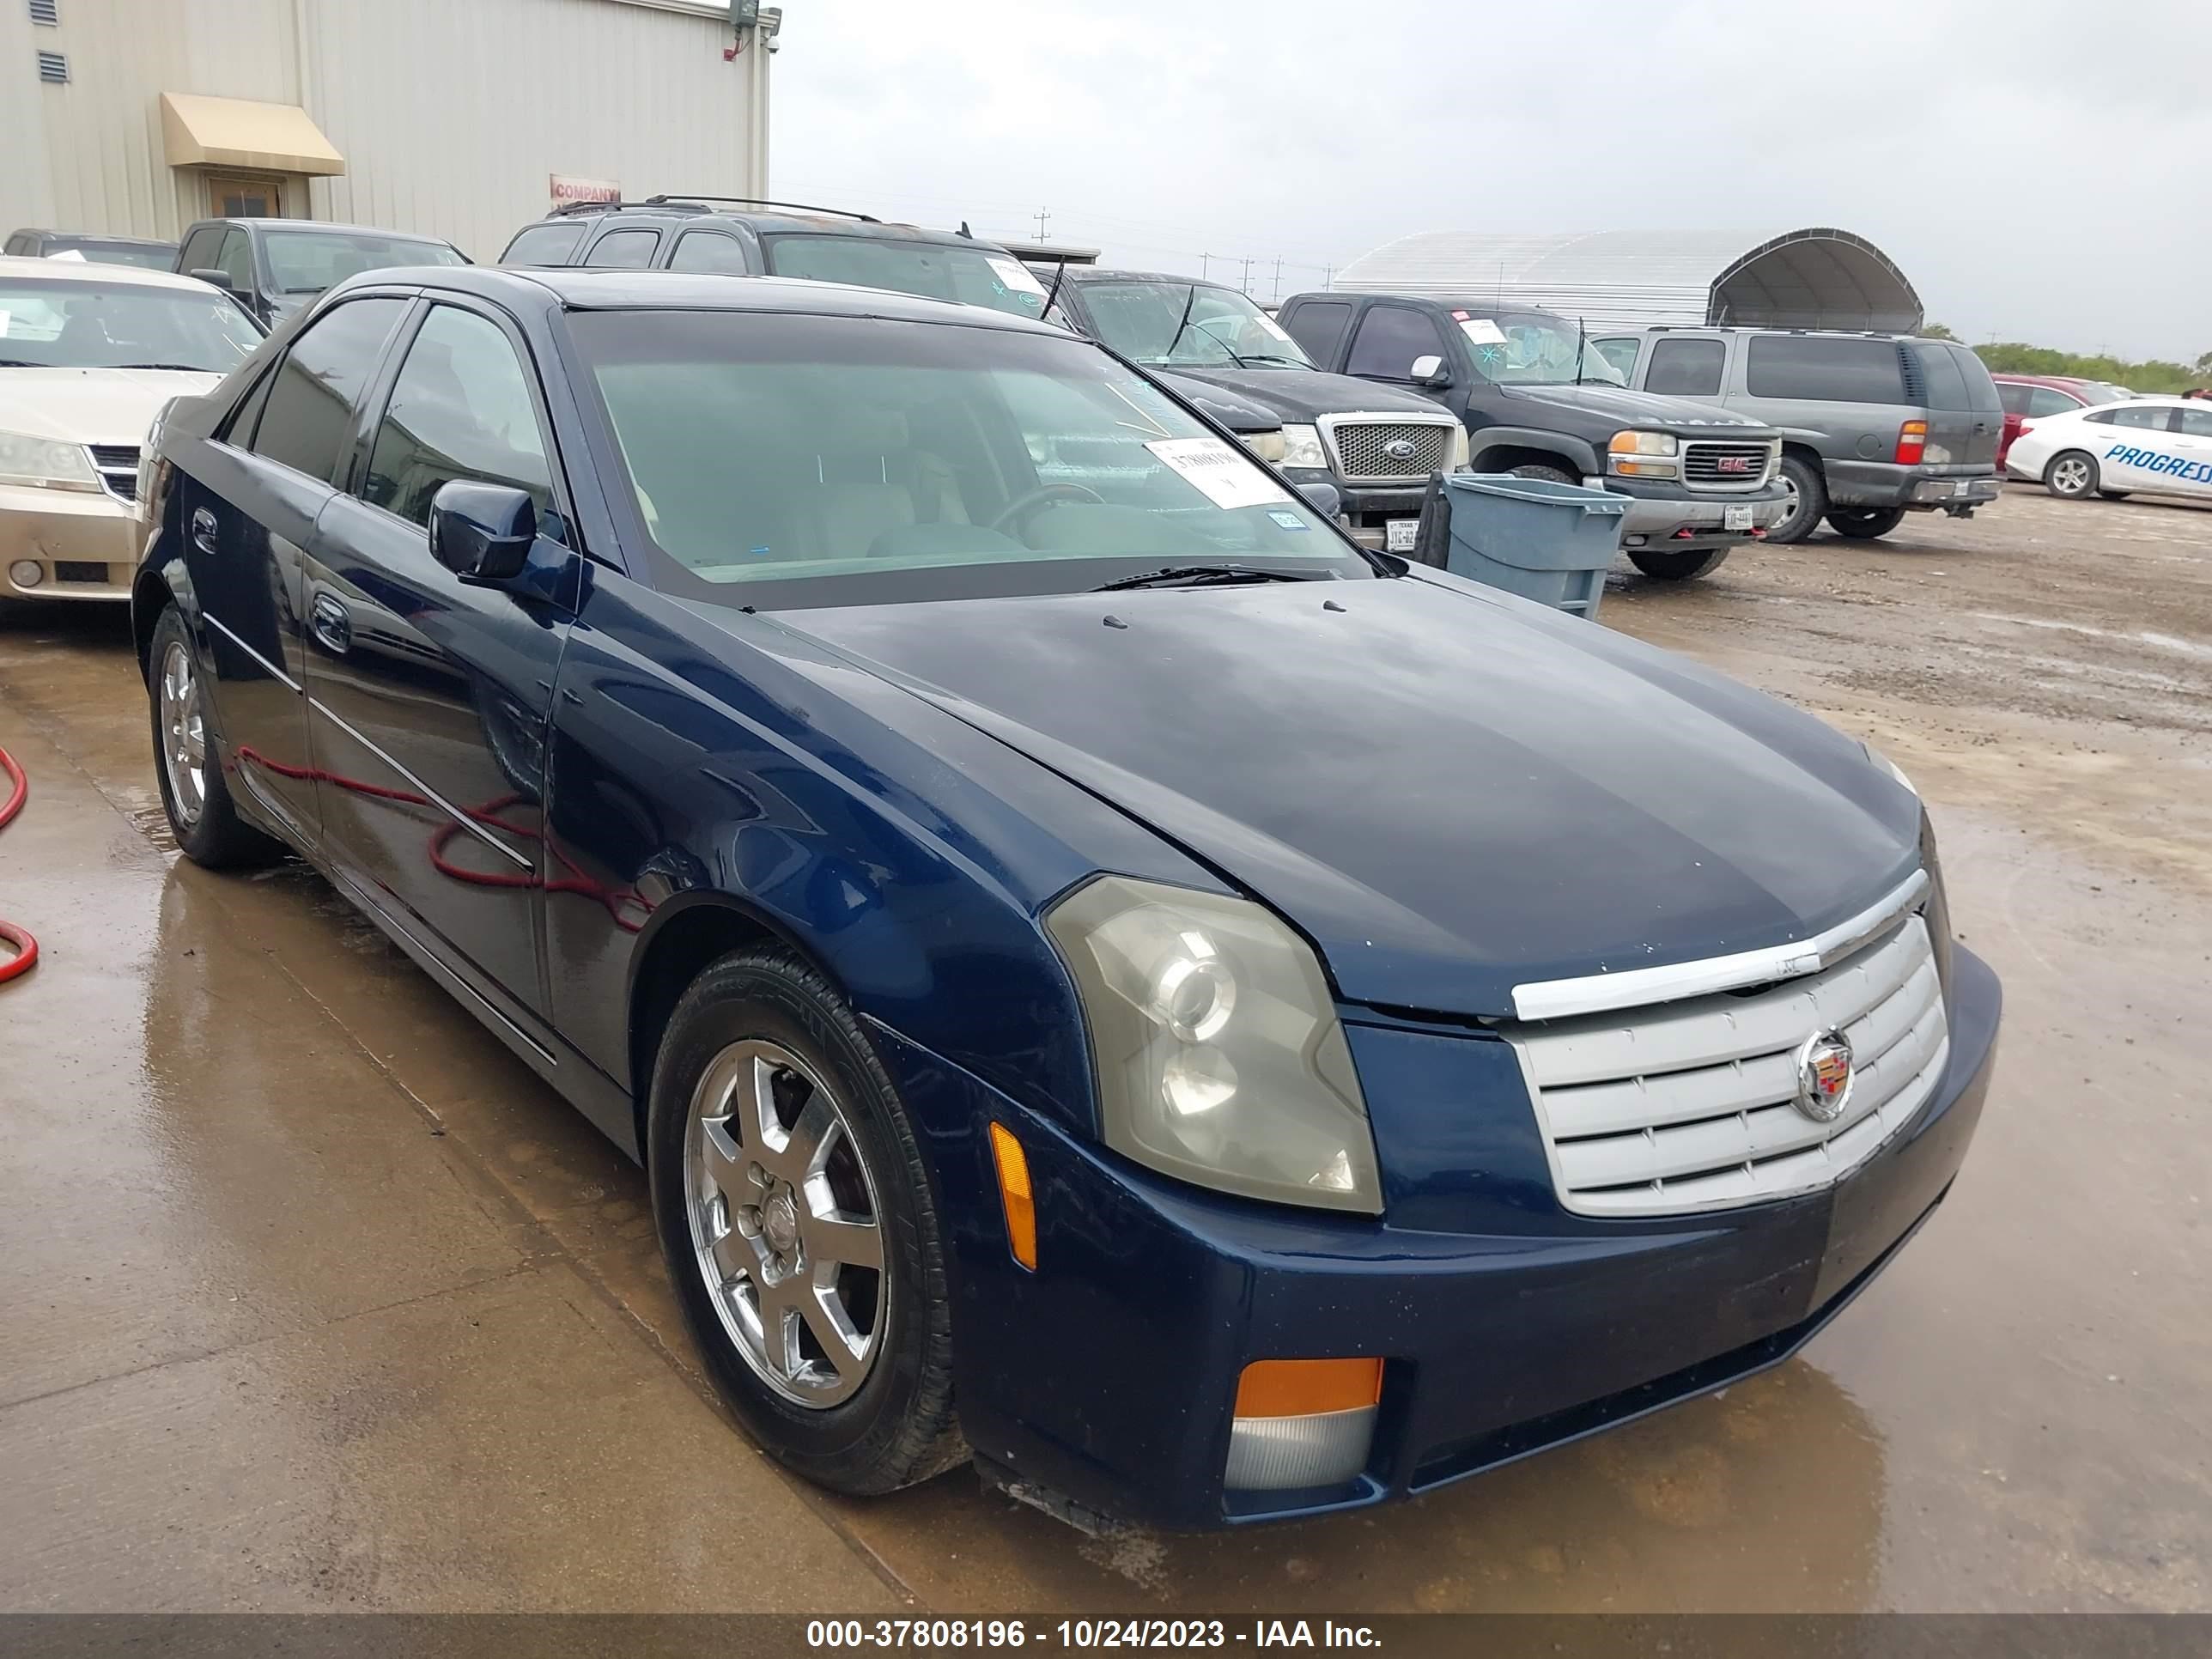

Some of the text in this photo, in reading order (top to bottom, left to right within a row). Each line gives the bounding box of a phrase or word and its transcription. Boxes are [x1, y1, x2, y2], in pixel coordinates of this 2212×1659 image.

[556, 183, 616, 202] COMPANY
[1170, 453, 1240, 469] 37808196
[1718, 457, 1750, 472] GMC
